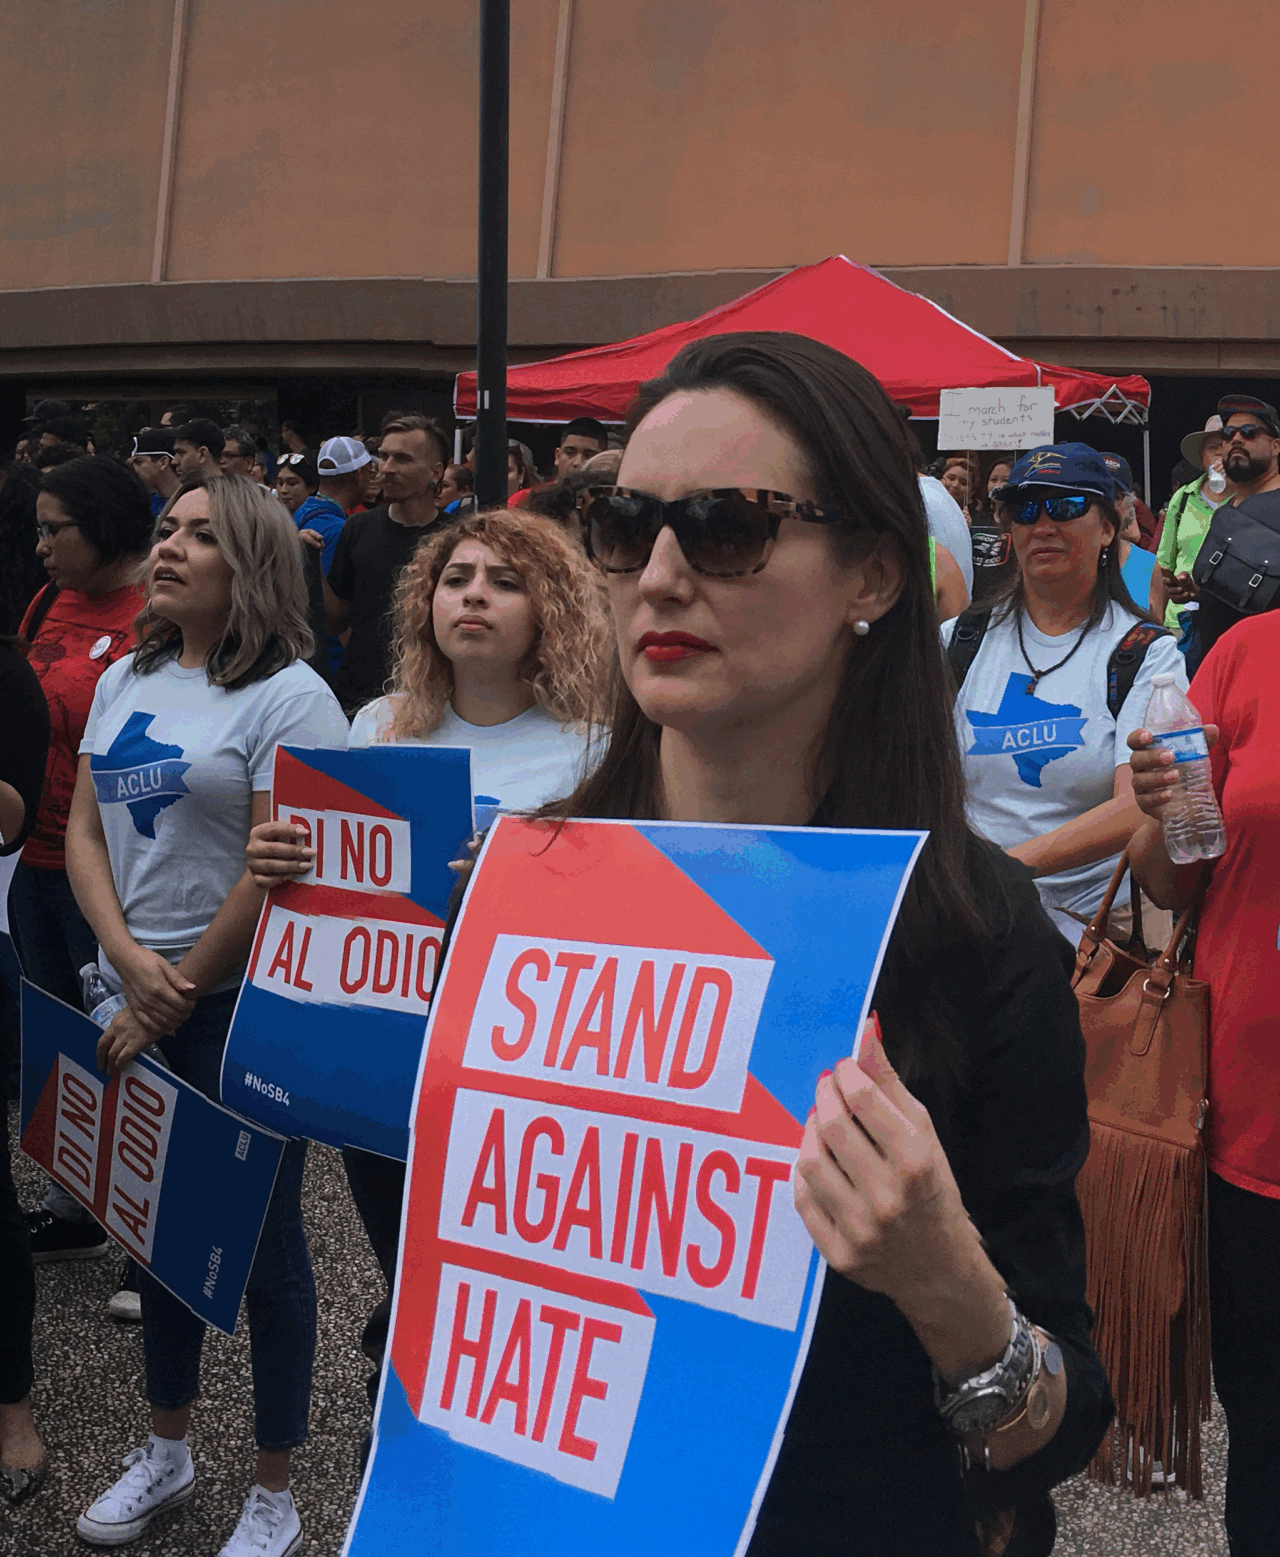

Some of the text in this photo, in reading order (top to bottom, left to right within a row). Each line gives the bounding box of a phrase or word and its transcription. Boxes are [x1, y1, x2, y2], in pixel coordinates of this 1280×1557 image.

[944, 391, 1038, 417] I march for
[959, 413, 1032, 431] my students
[1002, 723, 1057, 750] ACLU
[117, 766, 162, 799] ACLU
[340, 818, 393, 887] NO
[267, 920, 443, 1002] AL ODIO
[490, 947, 733, 1091] STAND
[244, 1071, 290, 1107] #NoSB4
[58, 1073, 97, 1189] DI NO
[112, 1076, 166, 1246] AL ODIO
[237, 1132, 249, 1158] ACLU
[460, 1107, 791, 1301] AGAINST
[202, 1244, 223, 1299] #NoSB4
[439, 1281, 623, 1462] HATE
